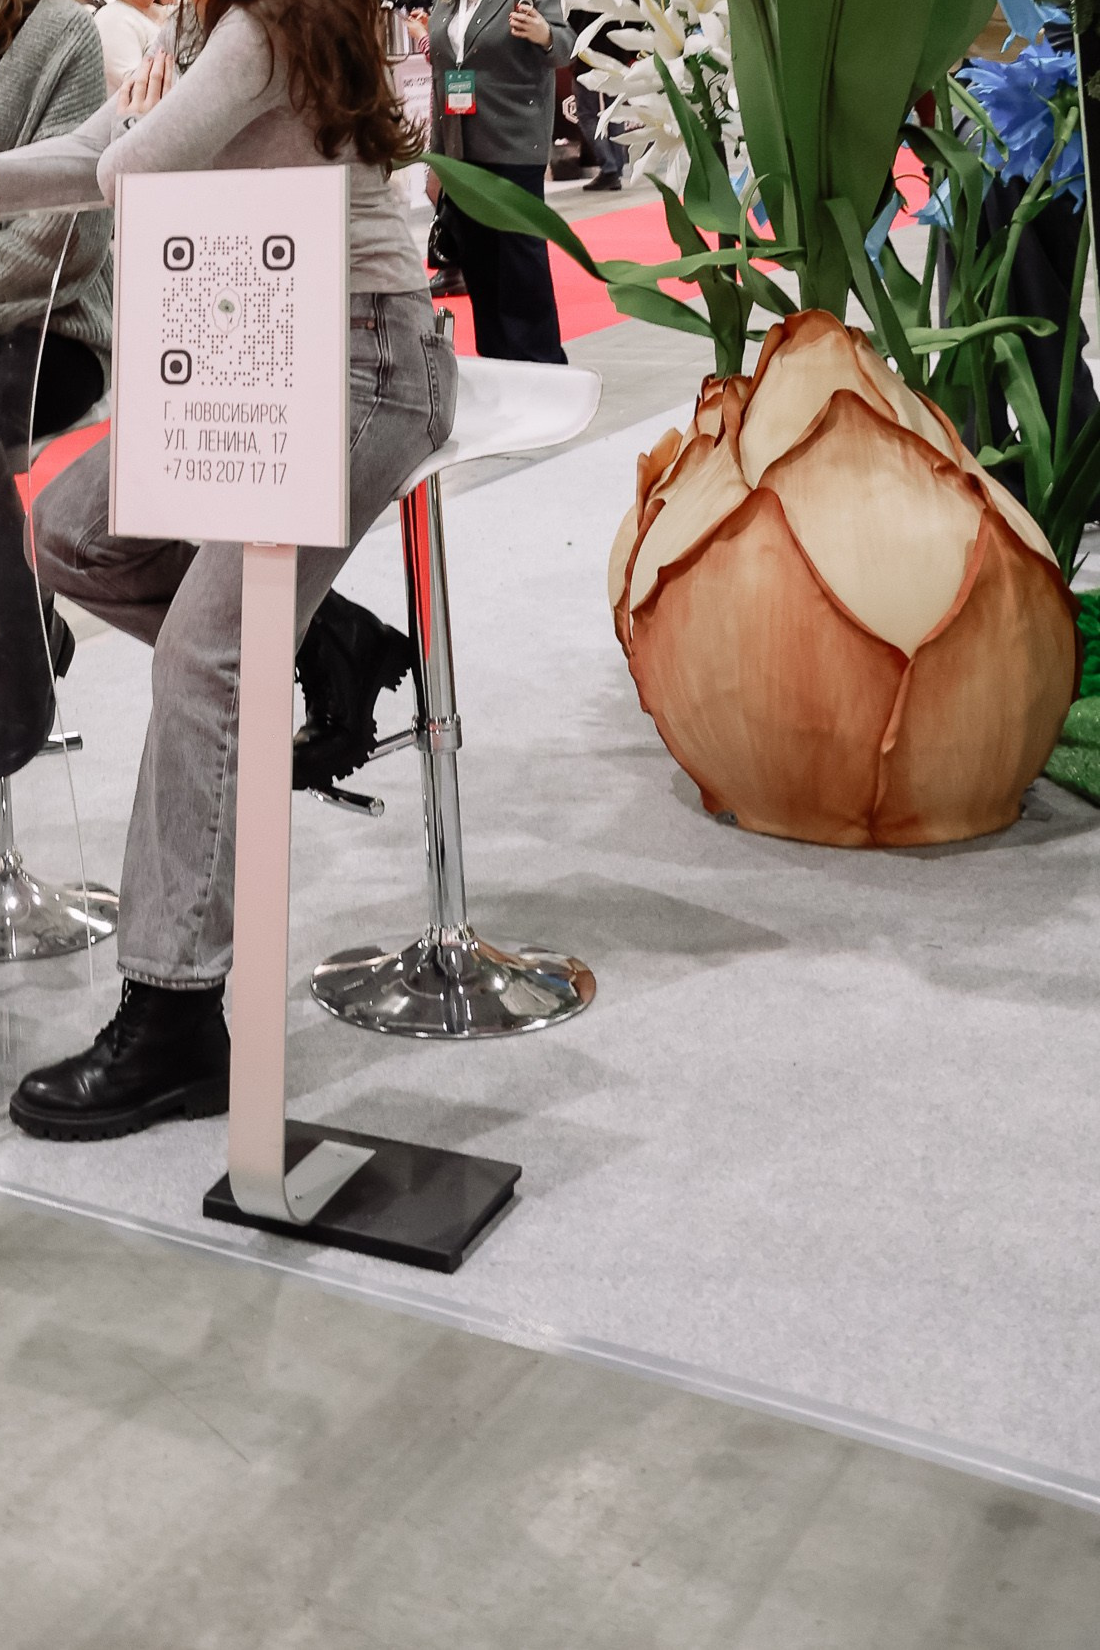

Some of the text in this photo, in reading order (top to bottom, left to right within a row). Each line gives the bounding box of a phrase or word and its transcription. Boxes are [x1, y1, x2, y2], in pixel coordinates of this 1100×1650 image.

[164, 401, 287, 424] Г. НОВОСИБИРСК
[164, 428, 288, 455] УЛ. ЛЕНИНА, 17
[164, 458, 288, 486] +7 913 207 17 17
